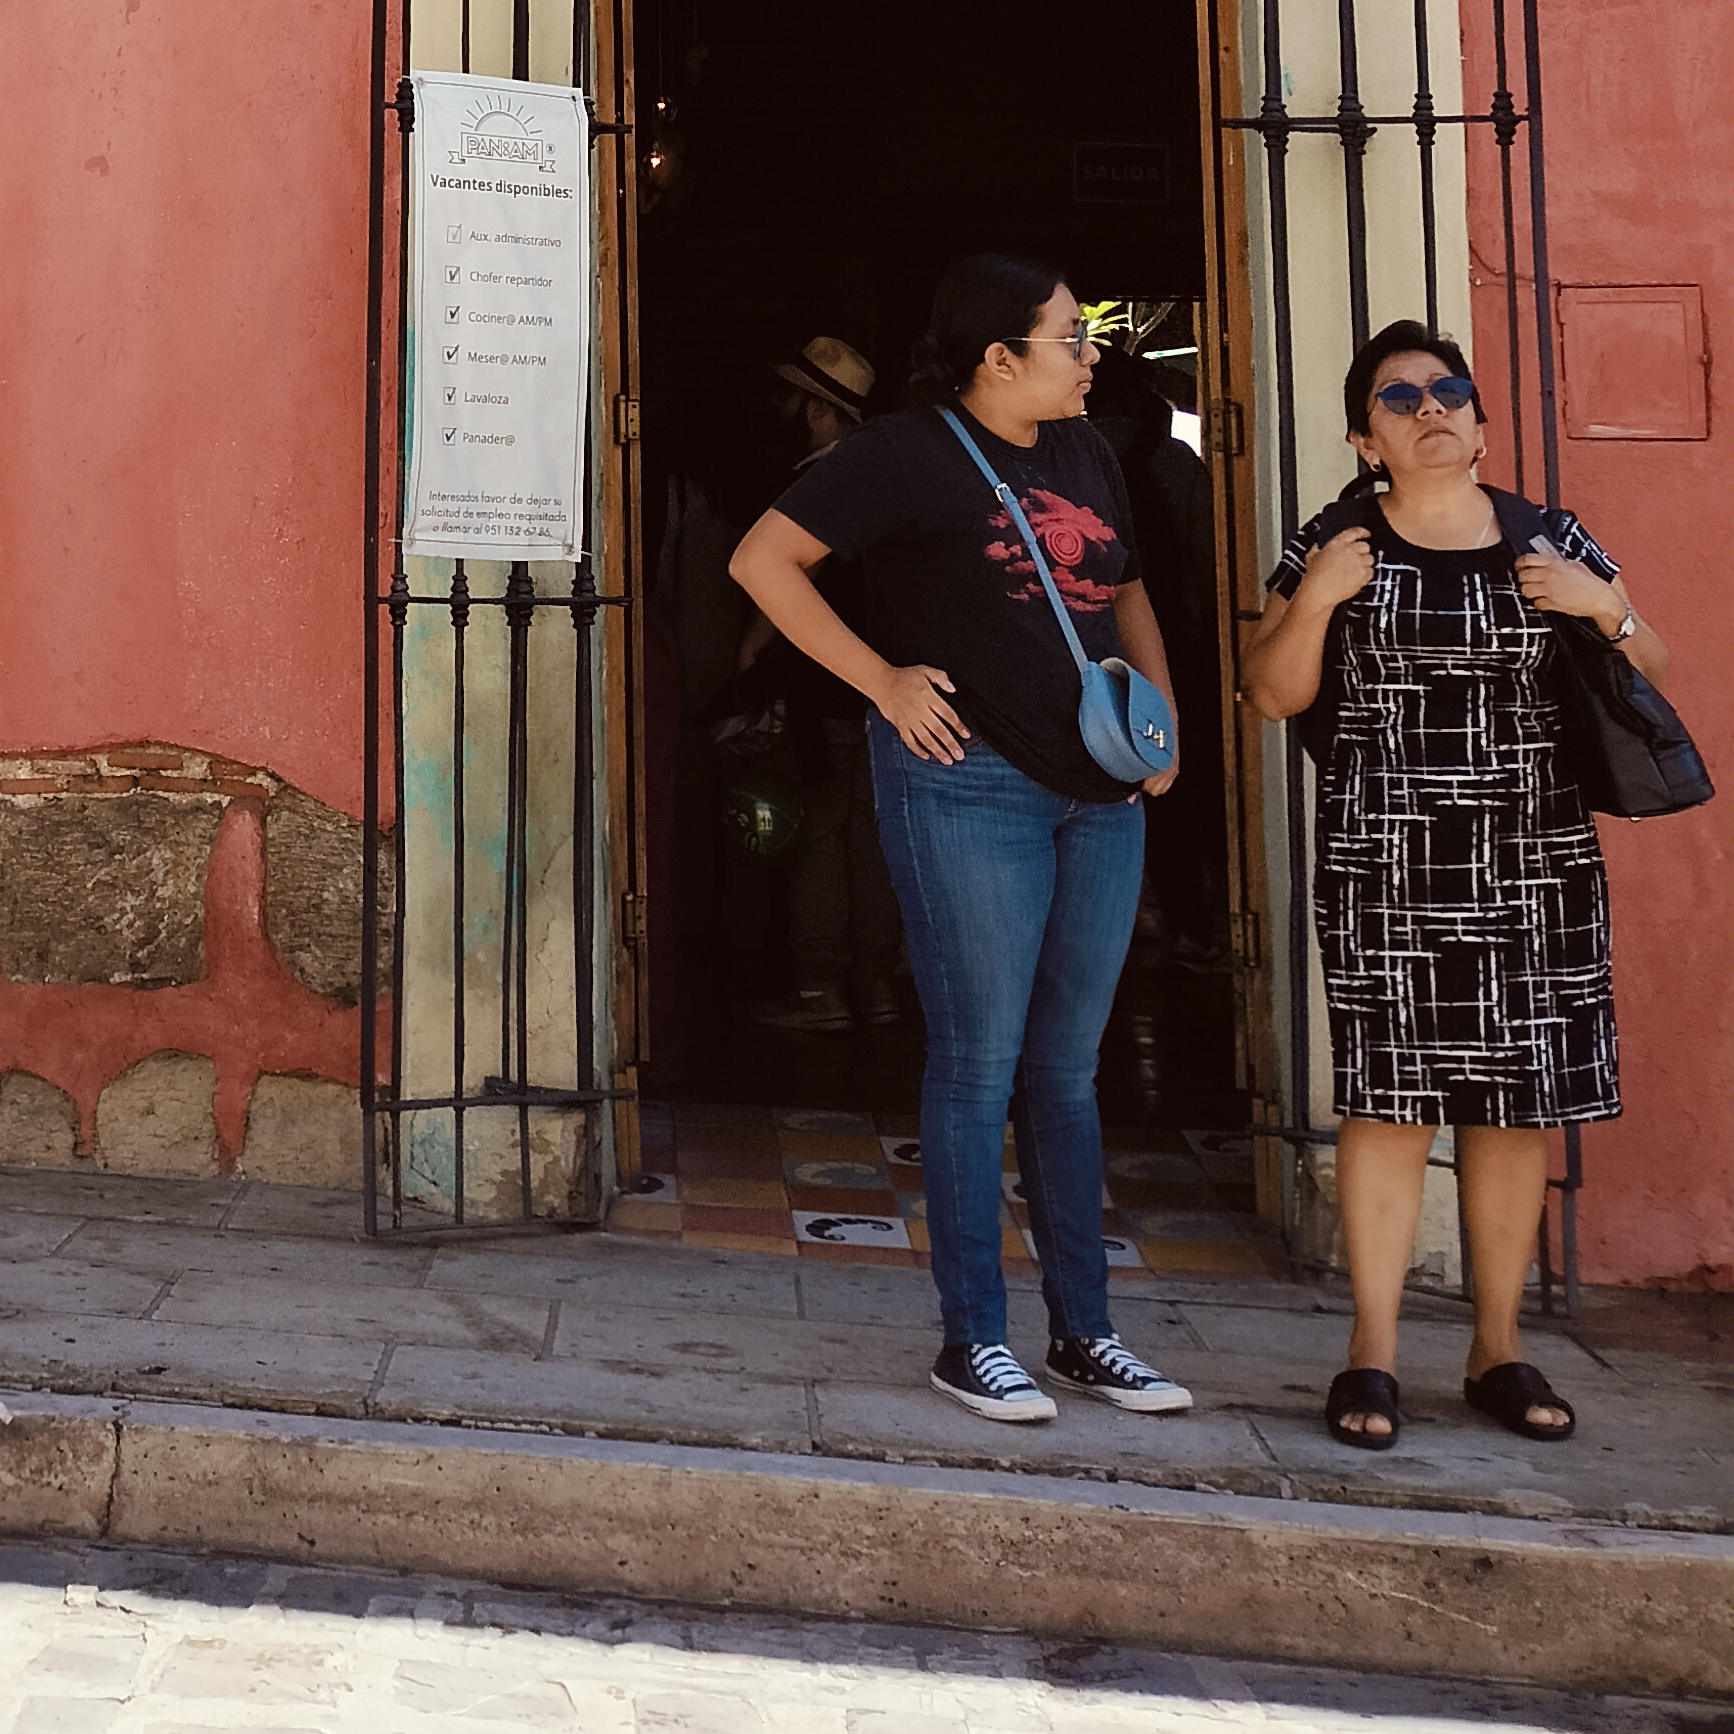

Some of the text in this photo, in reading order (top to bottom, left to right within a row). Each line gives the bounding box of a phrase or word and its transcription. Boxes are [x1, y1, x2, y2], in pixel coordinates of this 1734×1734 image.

[466, 135, 539, 161] PAN:AM
[1081, 163, 1160, 181] SALIDA
[430, 173, 573, 200] Vacantes disponibles:
[469, 230, 562, 248] Aux. administrativo
[469, 270, 554, 288] Chofer repartidor
[468, 311, 553, 327] Cociner@ AM/PM
[467, 351, 547, 367] Meser@ AM/PM
[464, 391, 509, 405] Lavaloza
[462, 432, 516, 446] Panader@
[428, 490, 479, 504] Interesados
[481, 491, 507, 505] favor
[509, 493, 523, 505] de
[526, 493, 552, 509] dejar
[420, 505, 567, 524] solicitud de empleo requisitada
[441, 521, 470, 534] llamar
[472, 523, 483, 535] al
[484, 524, 501, 536] 951
[504, 525, 521, 537] 132
